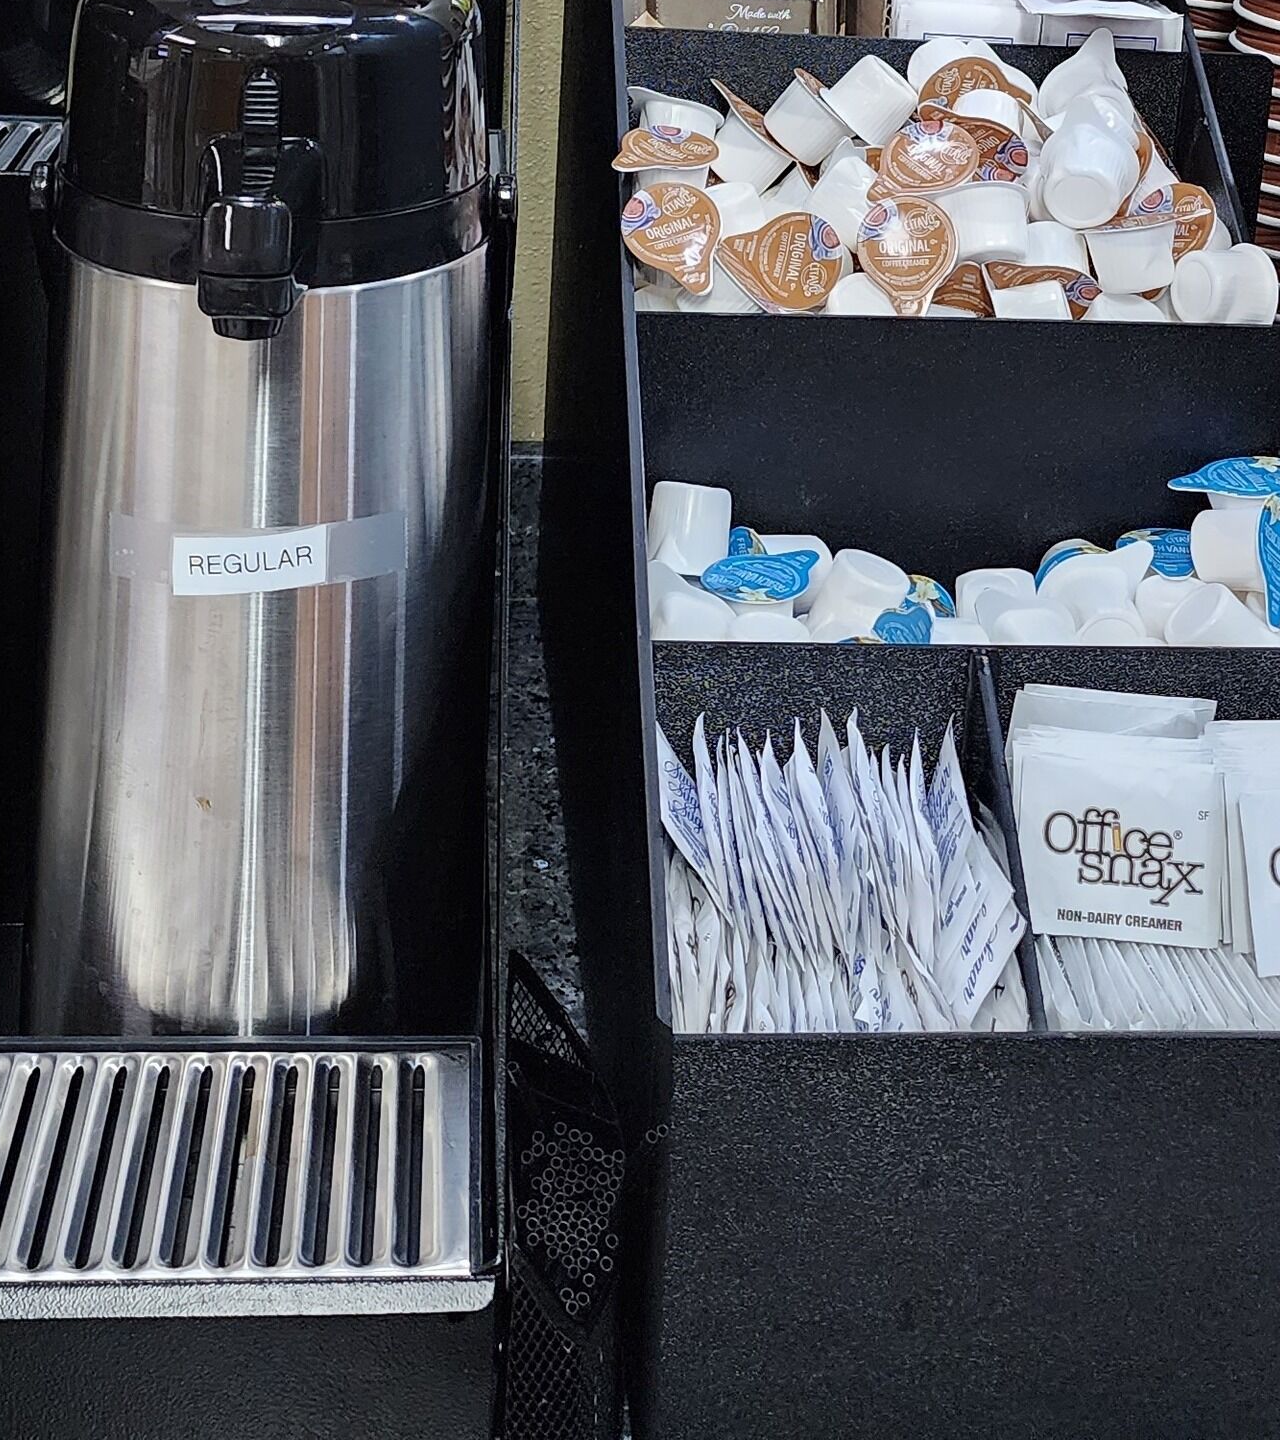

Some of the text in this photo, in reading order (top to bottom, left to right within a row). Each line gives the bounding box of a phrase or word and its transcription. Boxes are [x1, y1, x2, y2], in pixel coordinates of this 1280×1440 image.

[725, 4, 791, 21] Made with
[645, 216, 696, 240] ORIGINAL
[785, 232, 807, 282] ORIGINAL
[879, 239, 931, 256] ORIGINAL
[188, 545, 313, 576] REGULAR
[1198, 811, 1210, 820] SF
[1044, 807, 1173, 861] Office
[1078, 852, 1205, 906] snax
[1057, 909, 1183, 932] NON-DAIRY CREAMER
